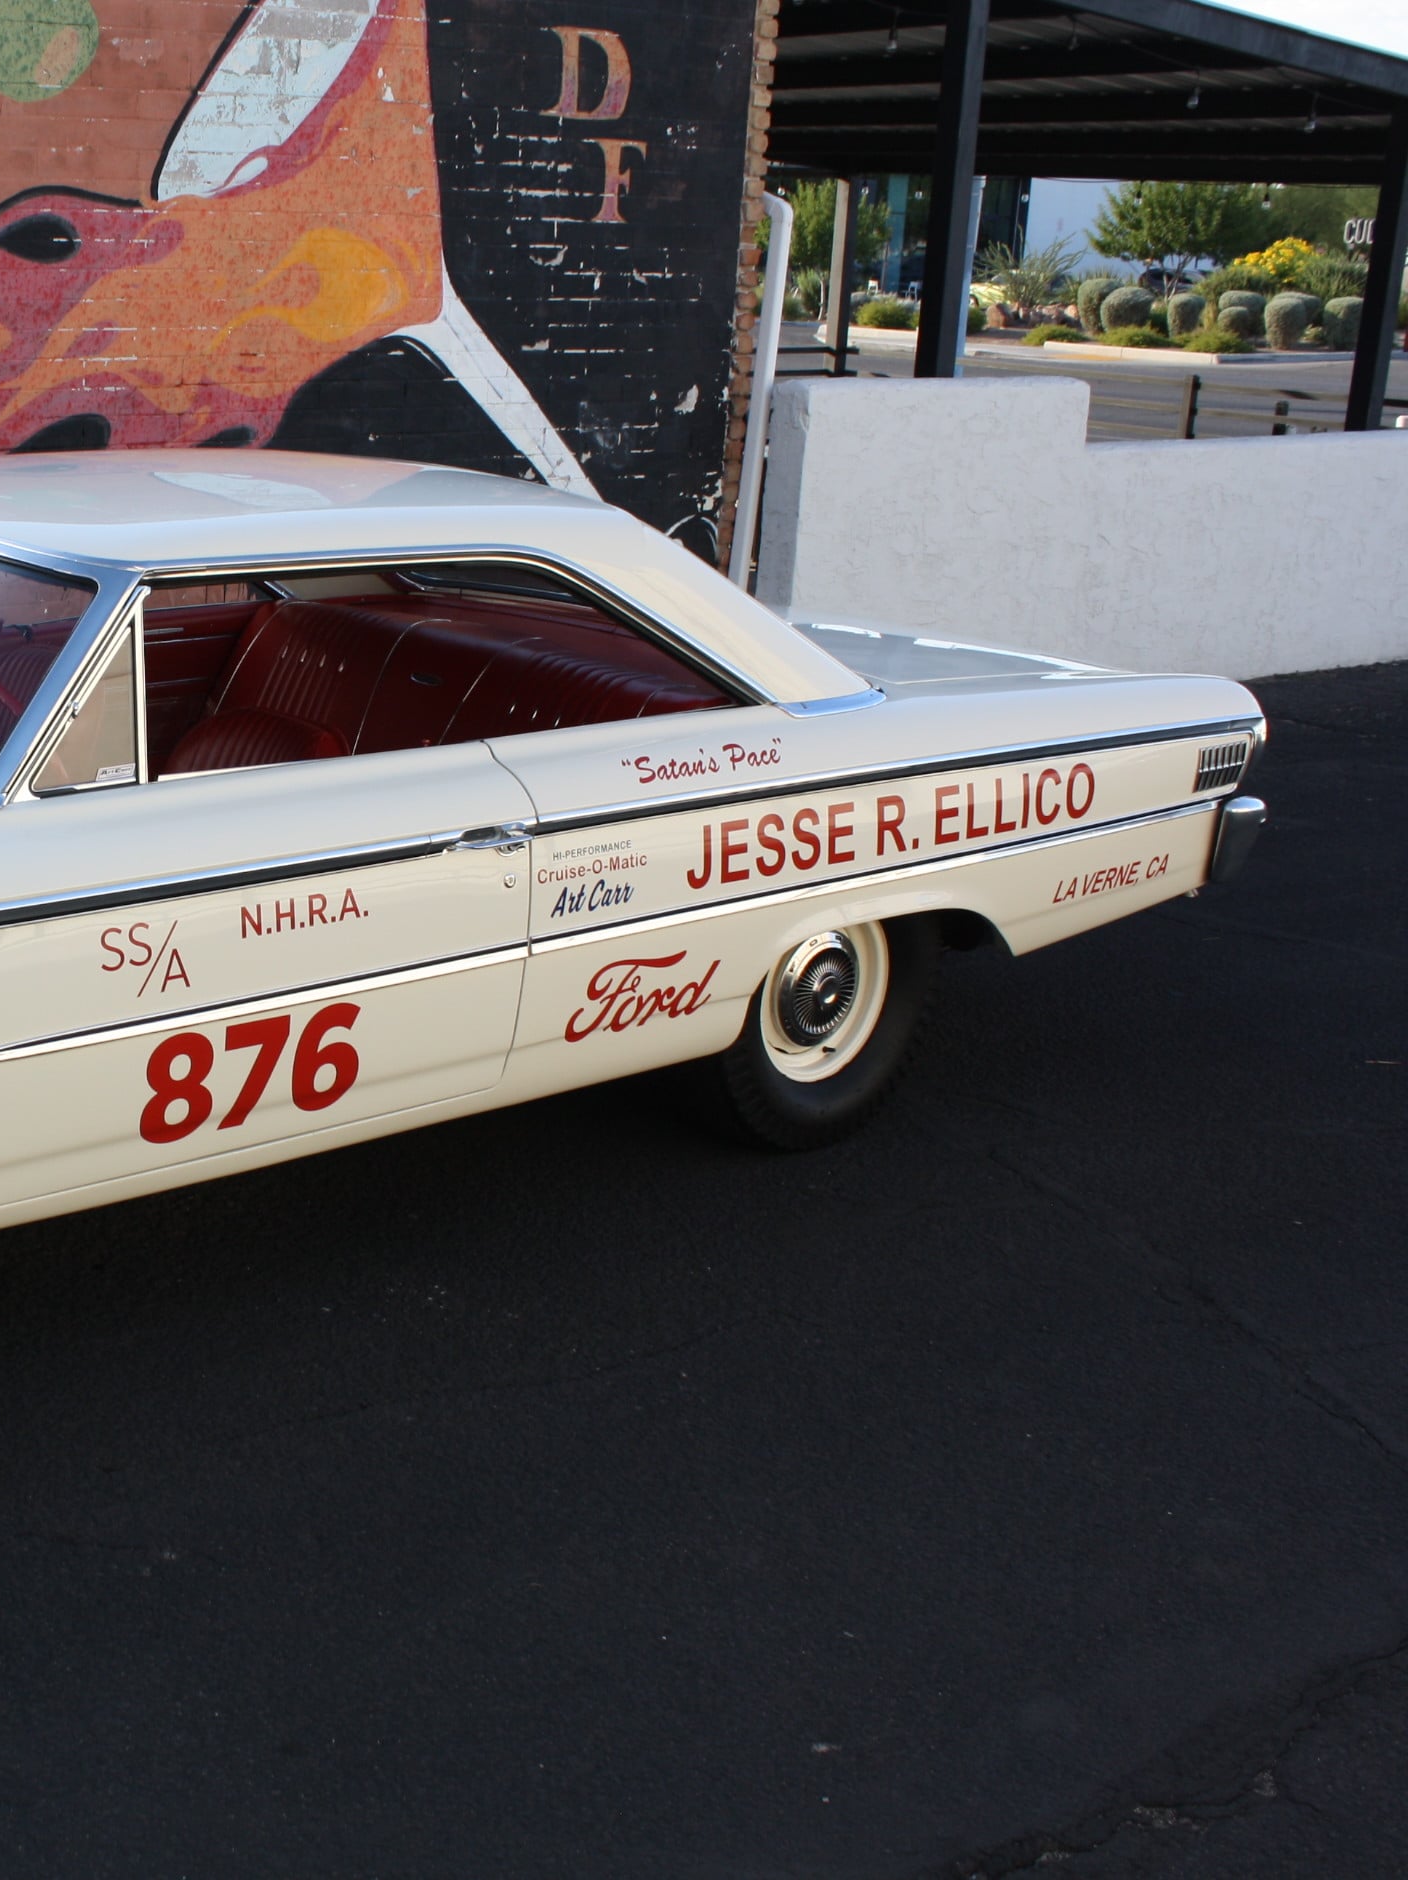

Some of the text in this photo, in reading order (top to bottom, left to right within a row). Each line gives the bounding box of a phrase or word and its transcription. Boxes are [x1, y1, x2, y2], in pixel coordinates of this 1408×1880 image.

[539, 26, 632, 120] D
[591, 138, 647, 224] F
[552, 839, 632, 861] HI-PERFORMANCE
[686, 762, 1096, 889] JESSE R. ELLICO
[537, 852, 648, 884] Cruise-O-Matic
[551, 879, 634, 918] Art Carr
[1052, 853, 1169, 904] LA VERNE, CA
[241, 888, 369, 939] N.H.R.A.
[564, 950, 721, 1042] Ford
[139, 1002, 361, 1144] 876
